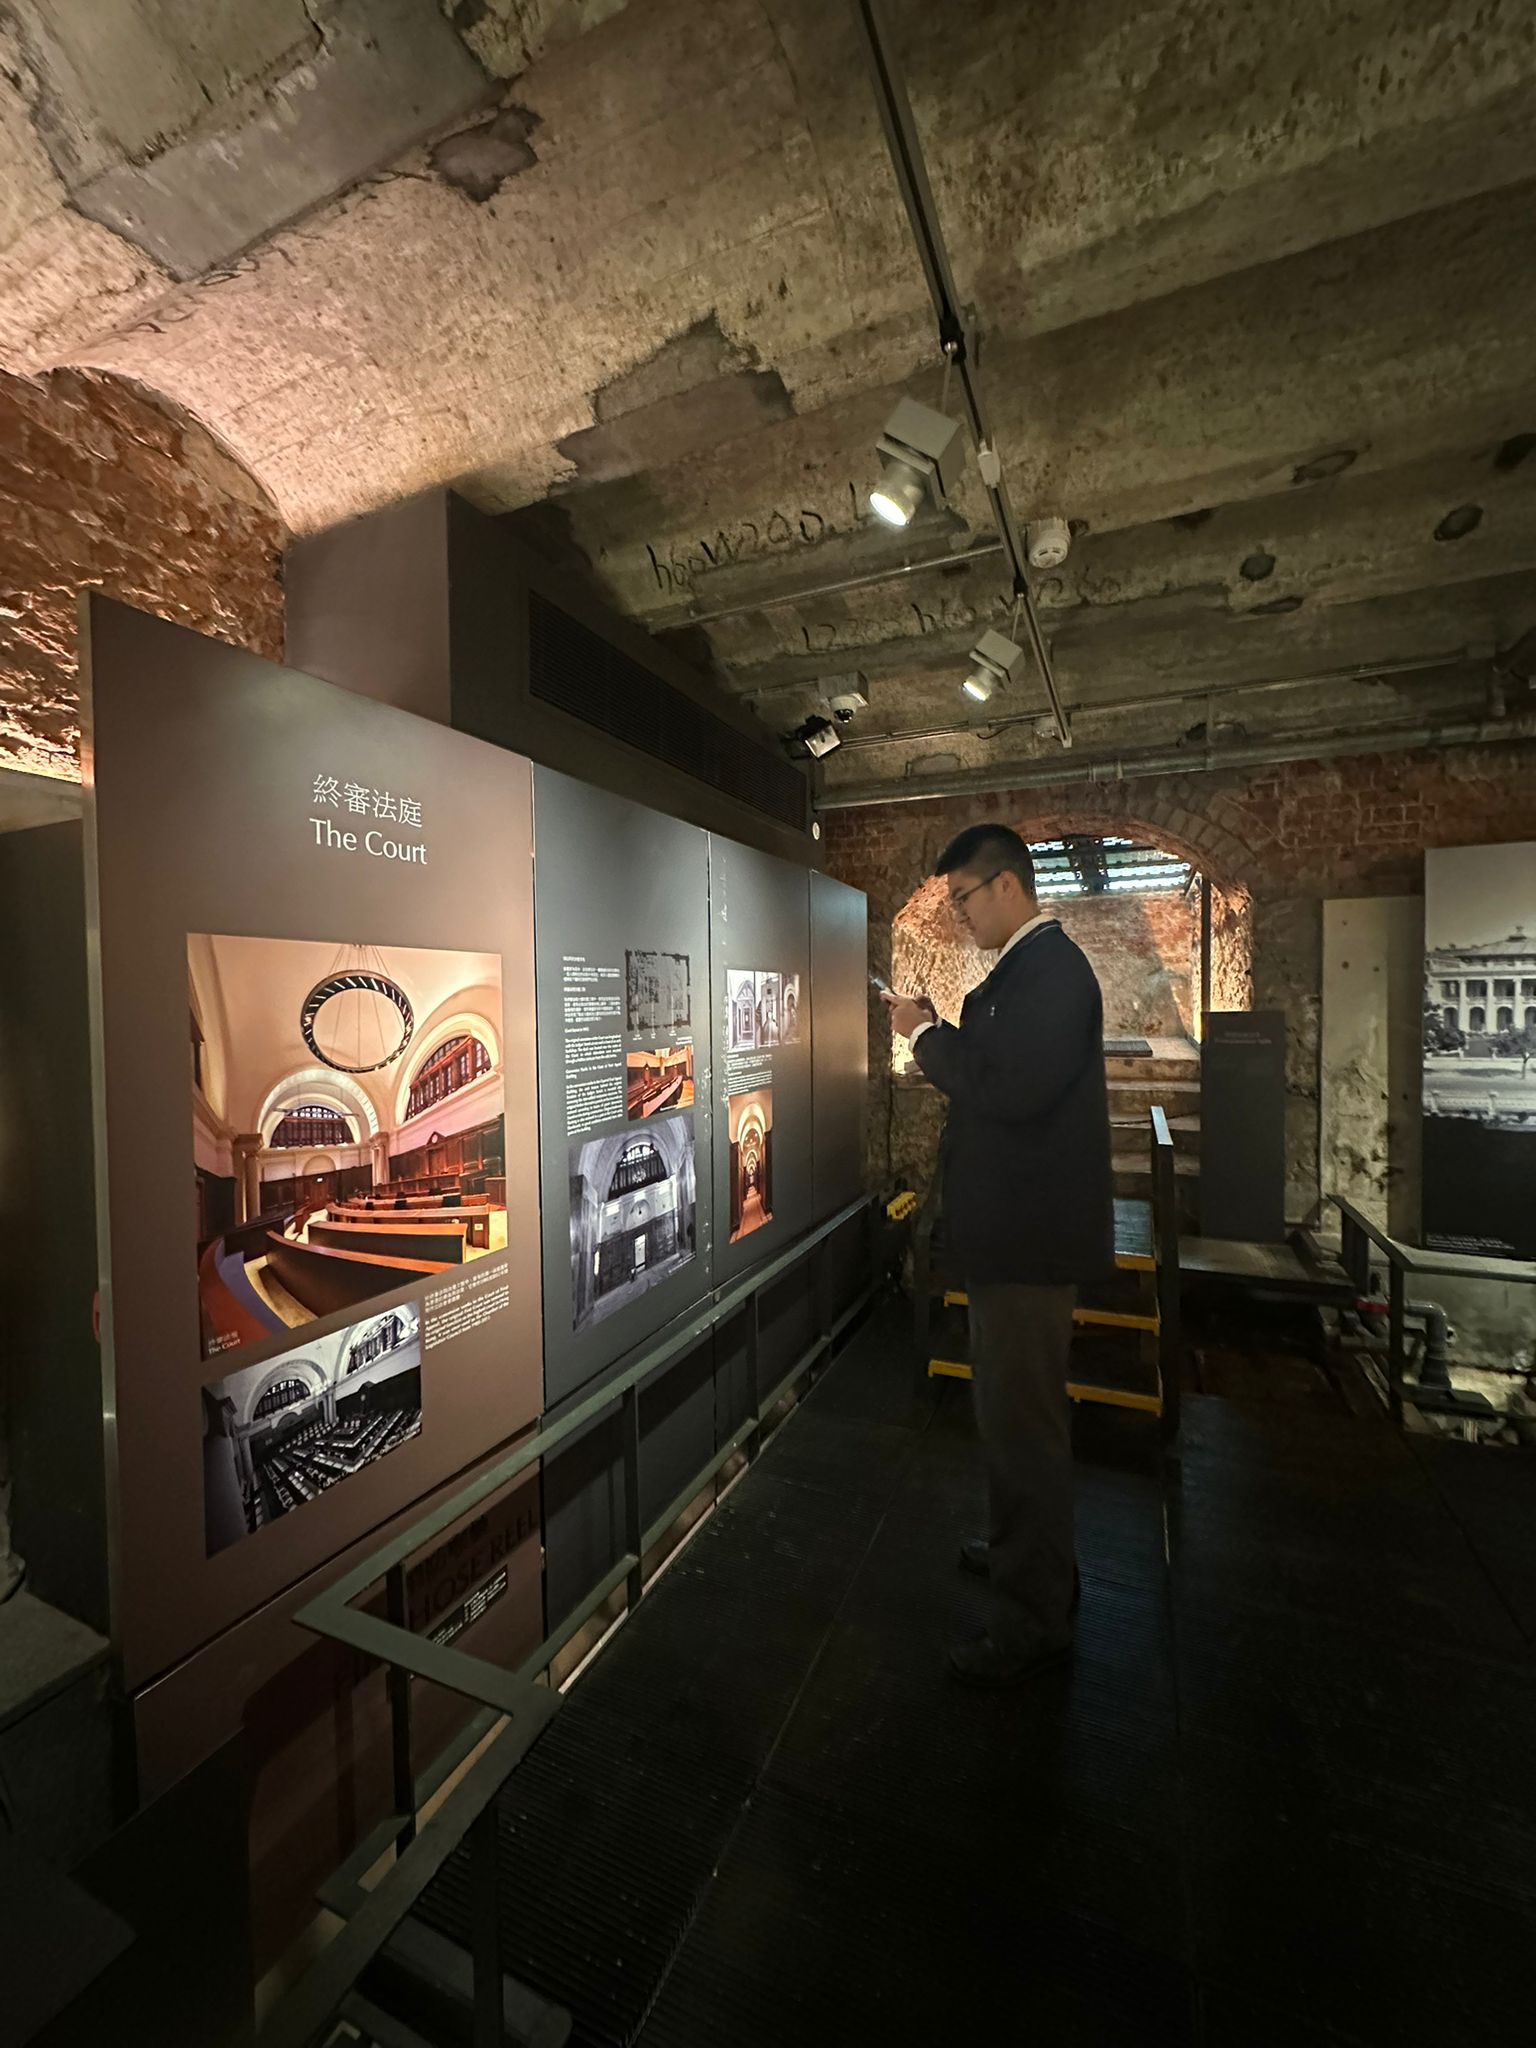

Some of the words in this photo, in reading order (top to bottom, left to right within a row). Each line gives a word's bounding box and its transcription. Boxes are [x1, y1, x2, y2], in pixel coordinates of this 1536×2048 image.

[313, 773, 423, 828] 終審法庭
[309, 817, 358, 851] The
[364, 830, 428, 865] Court
